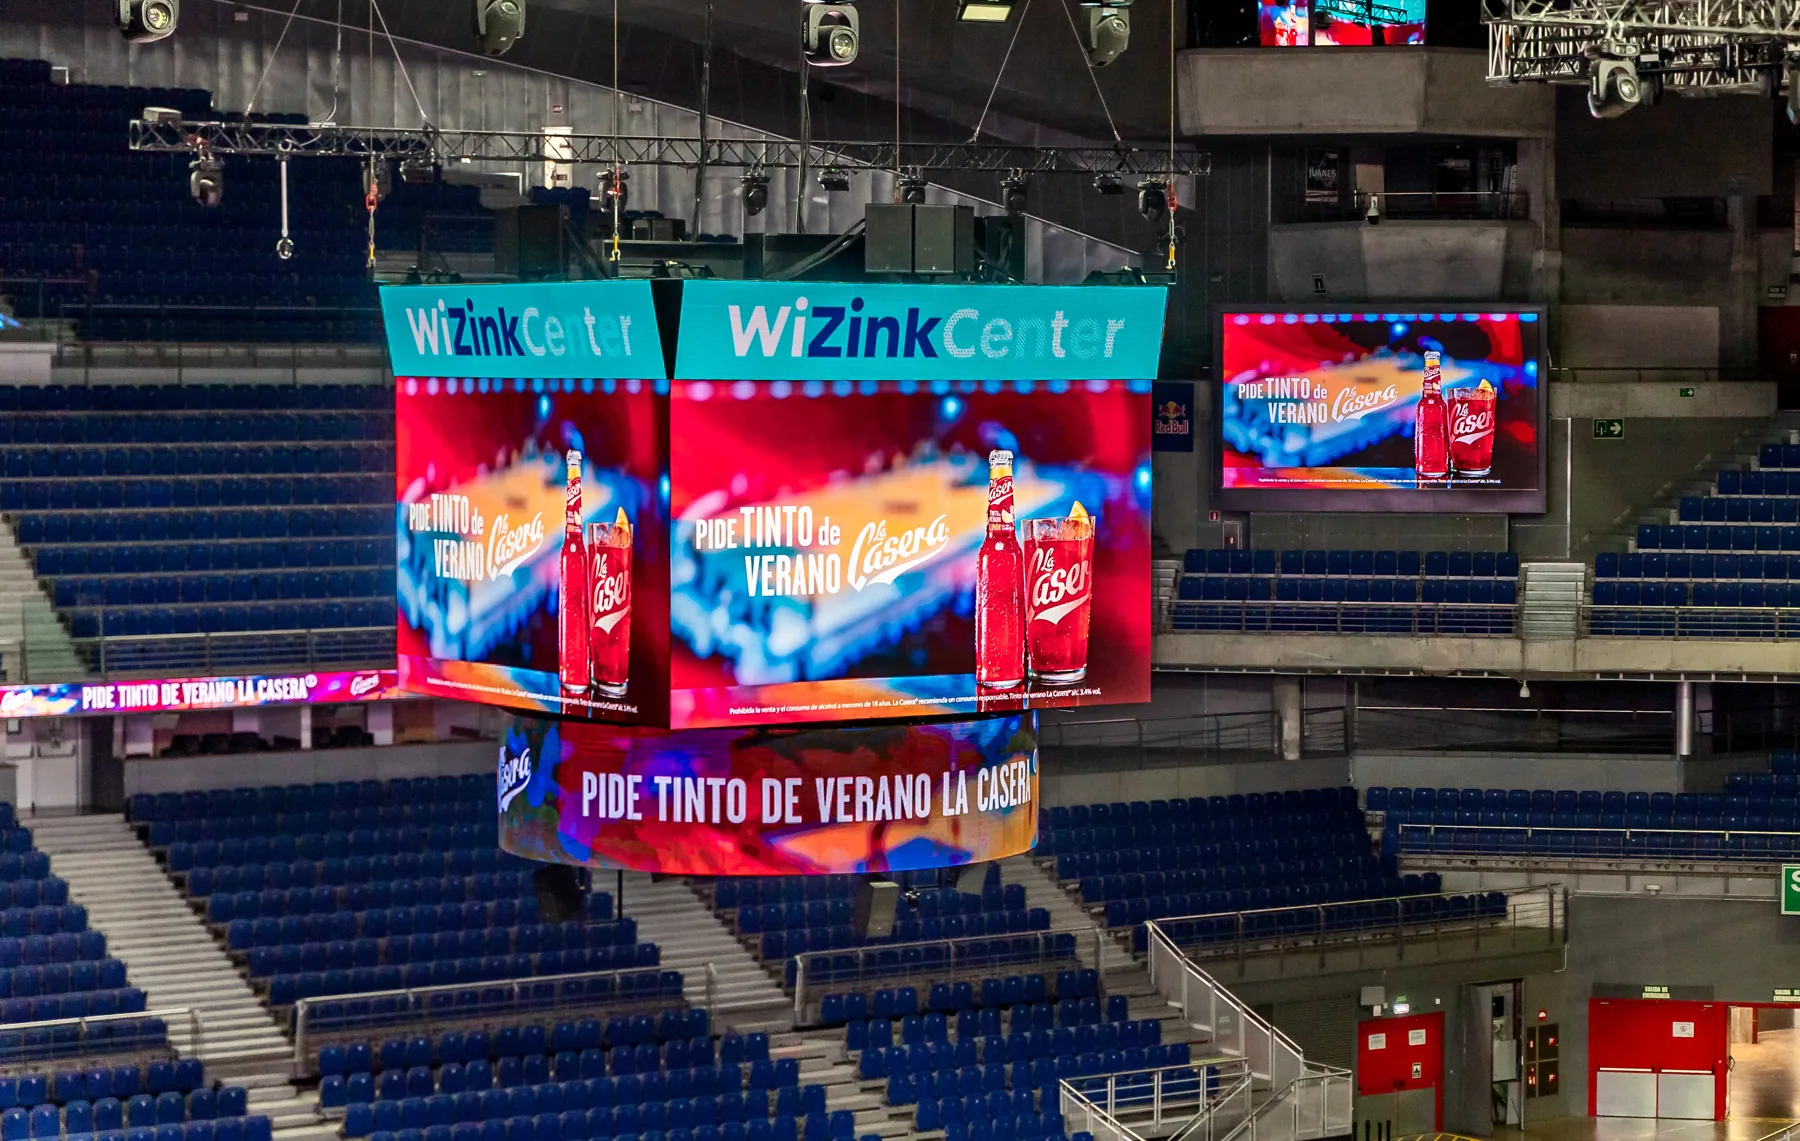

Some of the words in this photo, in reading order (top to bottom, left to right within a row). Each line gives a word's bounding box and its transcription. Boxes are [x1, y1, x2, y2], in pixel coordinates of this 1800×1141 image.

[1238, 384, 1263, 399] PIDE
[1265, 377, 1310, 399] TINTO
[1313, 385, 1327, 399] de
[1268, 403, 1328, 423] VERANO
[409, 503, 431, 531] PIDE
[431, 494, 469, 534] TINTO
[471, 507, 484, 535] de
[695, 518, 737, 550] PIDE
[740, 505, 813, 548] TINTO
[818, 516, 841, 546] de
[872, 520, 887, 542] La
[433, 538, 484, 581] VERANO
[745, 553, 841, 597] VERANO
[82, 686, 116, 710] PIDE
[117, 684, 158, 708] TINTO
[161, 683, 181, 706] DE
[182, 681, 235, 705] VERANO
[238, 680, 255, 702] LA
[729, 706, 755, 715] Prohibida
[786, 704, 810, 712] consumo
[582, 771, 642, 820] PIDE
[654, 776, 747, 824] TINTO
[761, 777, 802, 824] DE
[815, 773, 931, 823] VERANO
[942, 769, 968, 817] LA
